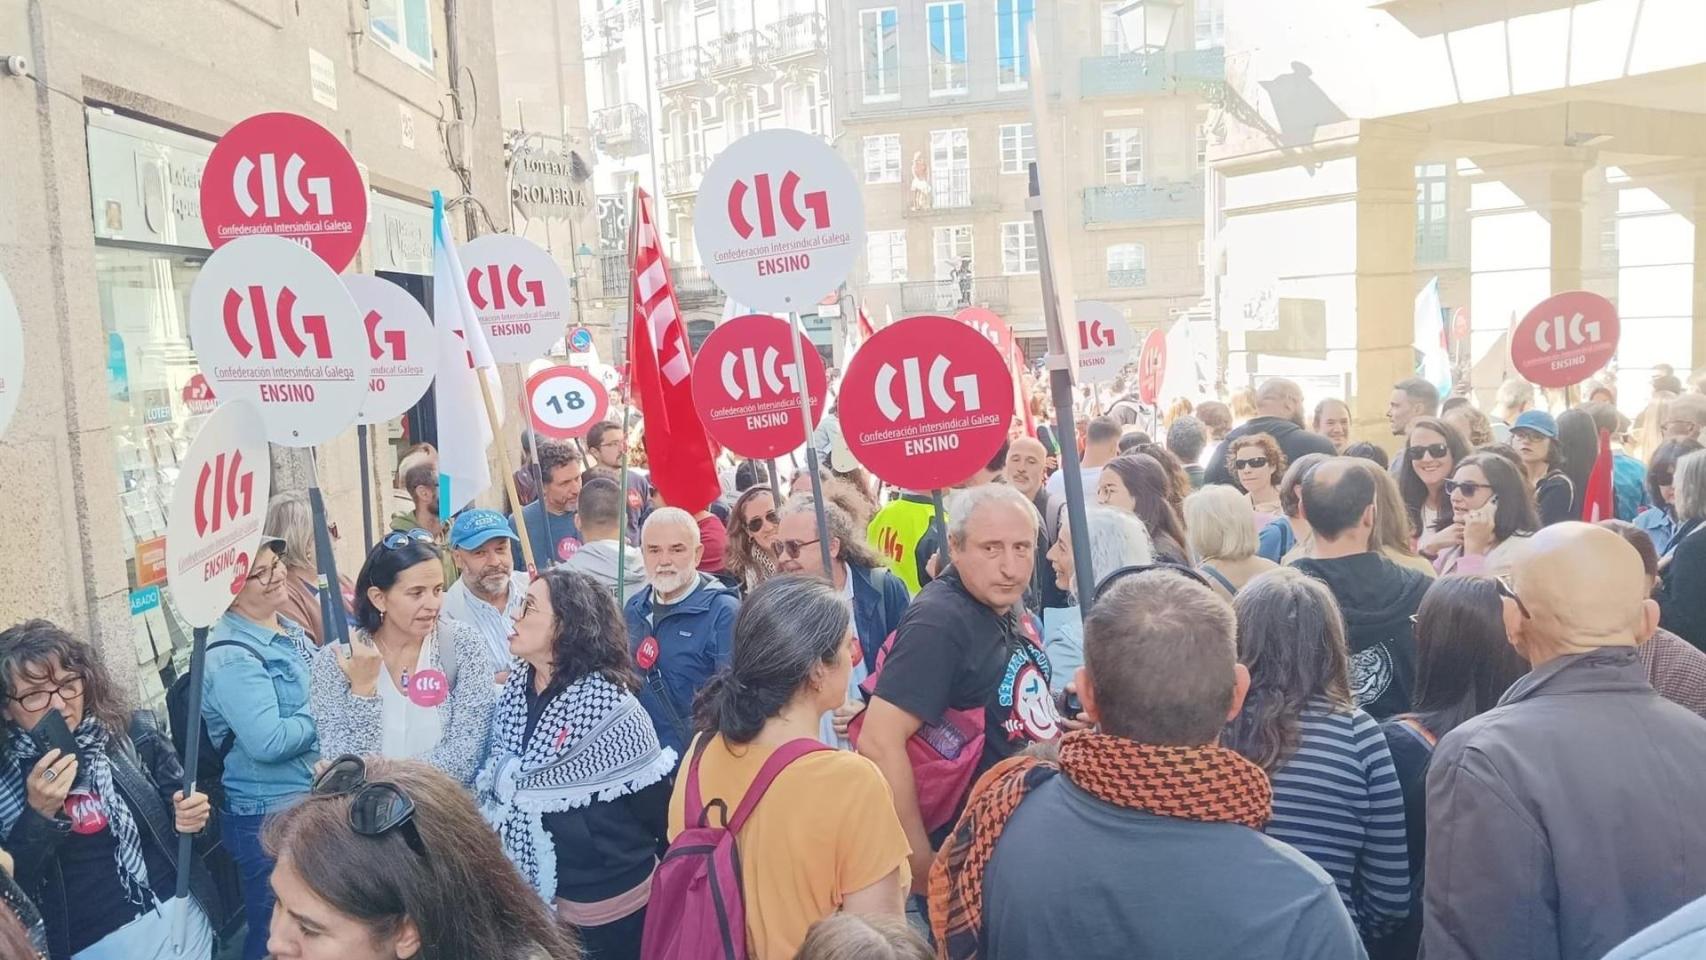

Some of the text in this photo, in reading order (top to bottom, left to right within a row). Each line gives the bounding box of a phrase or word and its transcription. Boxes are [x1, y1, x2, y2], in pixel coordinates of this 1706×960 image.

[233, 153, 334, 218] CIG
[728, 170, 830, 240] CIG
[218, 220, 353, 235] Confederación Intersindical Galega
[714, 231, 850, 262] Confederación Intersindical Galega
[757, 254, 810, 276] ENSINO
[467, 264, 546, 310] CIG
[223, 286, 333, 359] CIG
[491, 322, 531, 336] ENSINO
[1078, 320, 1115, 350] IG
[1535, 312, 1601, 353] CIG
[214, 366, 354, 380] Confederación Intersindical Galega
[721, 345, 801, 401] CIG
[1551, 355, 1586, 371] ENSINO
[259, 384, 315, 402] ENSINO
[546, 391, 585, 414] 18
[874, 354, 981, 422] CIG
[746, 412, 789, 430] ENSINO
[859, 413, 1000, 443] Confederación Intersindical Galega
[904, 433, 959, 456] ENSINO
[194, 449, 254, 538] CIG
[204, 546, 236, 582] ENSINO
[416, 677, 441, 691] CIG
